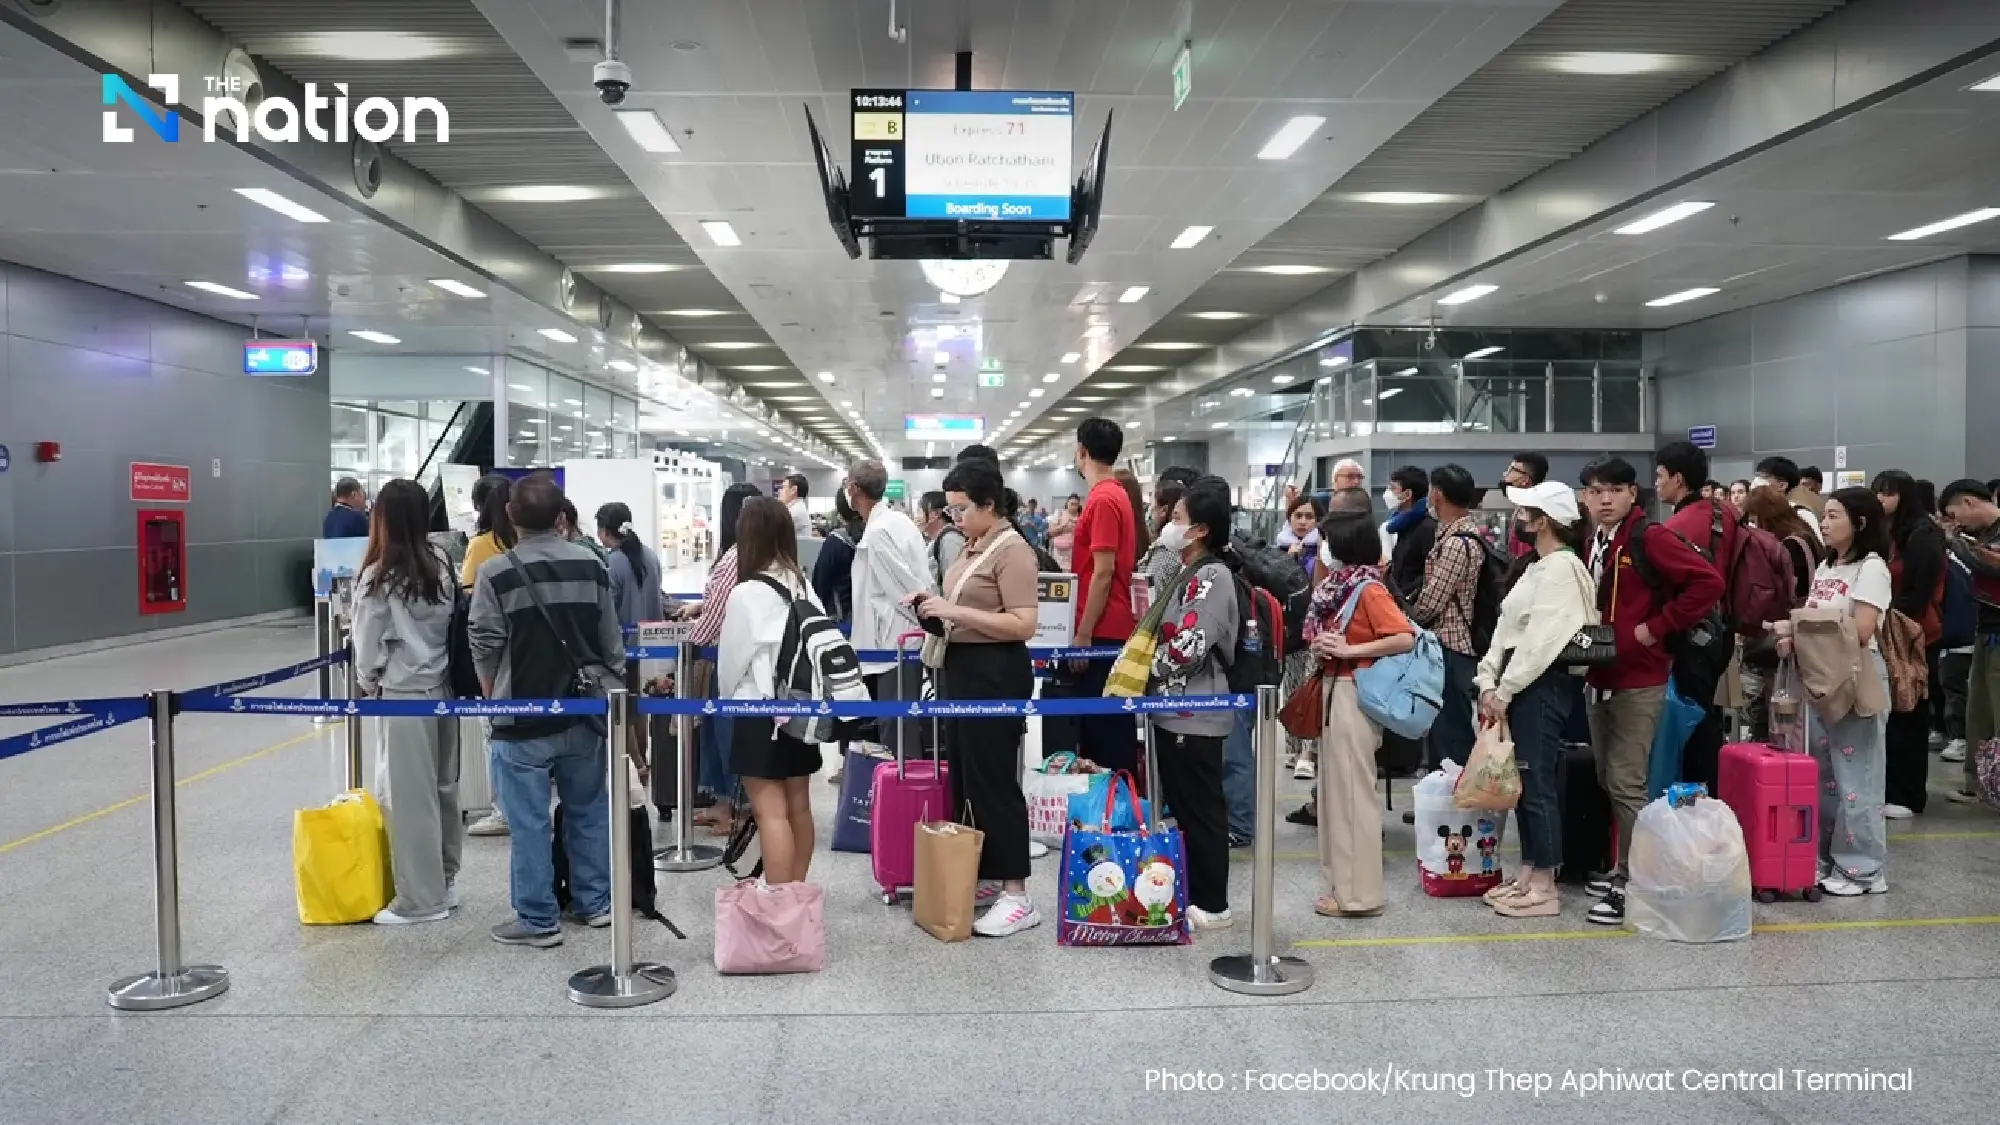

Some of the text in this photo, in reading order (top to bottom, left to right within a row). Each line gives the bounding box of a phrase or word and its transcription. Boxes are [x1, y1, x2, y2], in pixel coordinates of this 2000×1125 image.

[887, 120, 898, 134] B
[1006, 121, 1025, 136] 71
[925, 152, 1055, 167] Ubon Ratchathani
[868, 167, 886, 198] 1
[946, 201, 1032, 216] Boarding Soon
[1054, 584, 1064, 597] B
